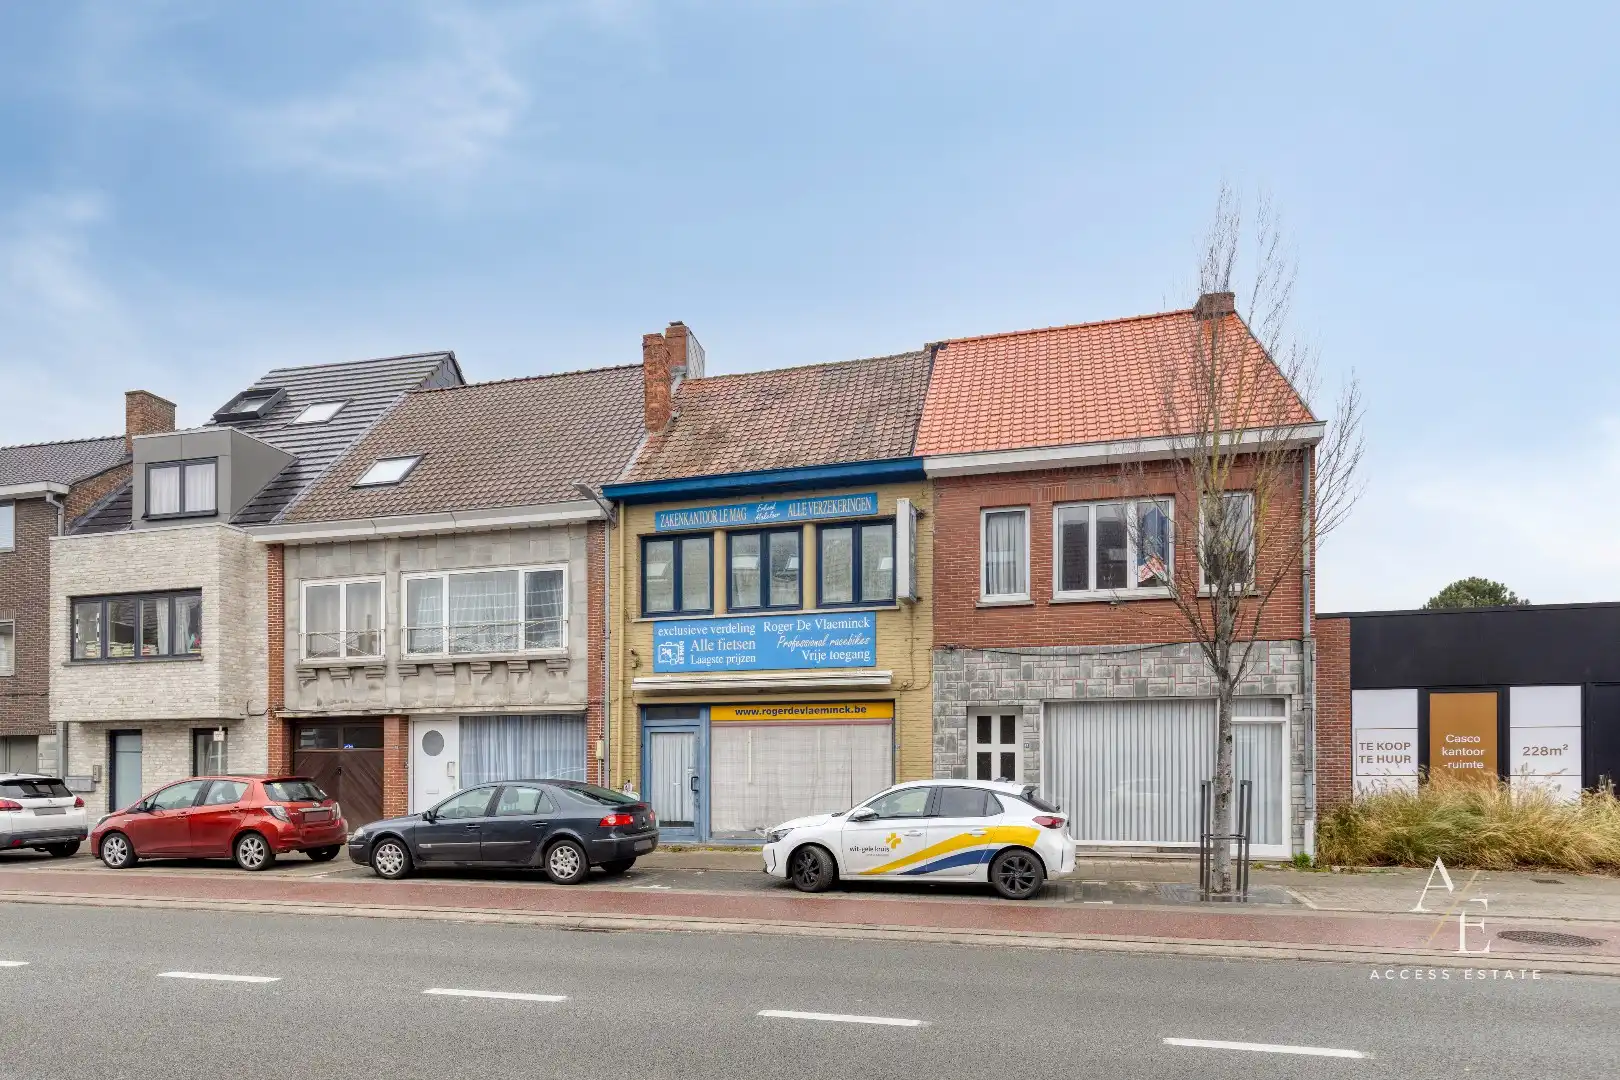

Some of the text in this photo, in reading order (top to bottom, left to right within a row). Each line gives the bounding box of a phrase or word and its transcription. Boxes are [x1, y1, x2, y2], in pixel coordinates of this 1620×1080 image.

[788, 496, 872, 517] ALLE VERZEKERINGEN
[660, 507, 747, 528] ZAKENKANTOOR LE MAG
[658, 622, 756, 636] exclusieve verdeling
[764, 617, 870, 634] Roger De Vlaeminck
[690, 638, 756, 652] Alle fietsen
[690, 654, 756, 667] Laagste prijzen
[802, 649, 871, 664] Vrije toegang
[734, 706, 867, 717] www.rogerdevlaeminck.be
[1446, 734, 1480, 744] Casco
[1359, 742, 1412, 751] TE KOOP
[1442, 746, 1485, 756] kantoor
[1359, 755, 1412, 764] TE HUUR
[1443, 760, 1484, 769] -ruimte
